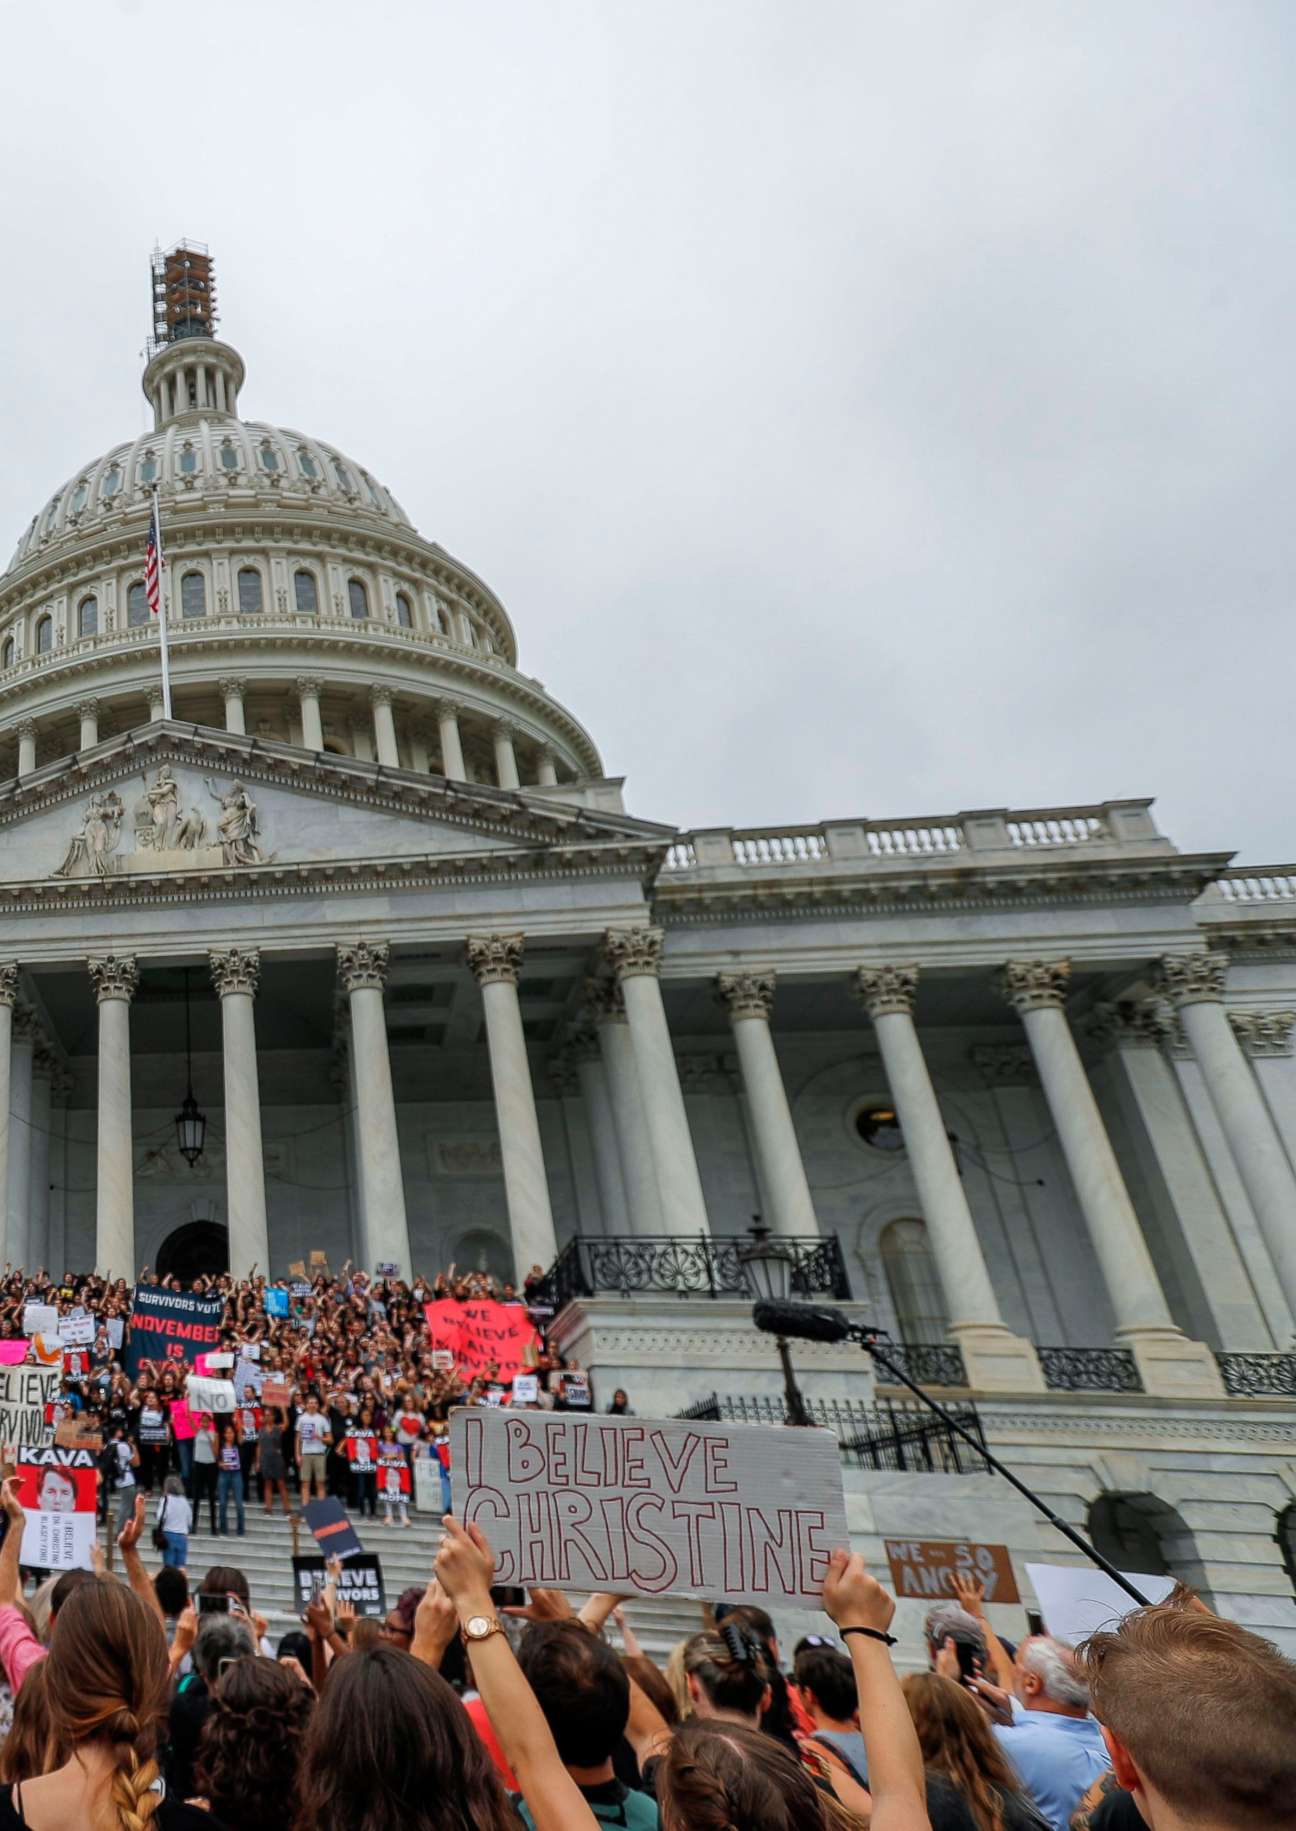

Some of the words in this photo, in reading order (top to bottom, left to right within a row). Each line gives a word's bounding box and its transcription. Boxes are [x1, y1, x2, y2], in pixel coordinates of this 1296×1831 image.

[138, 1292, 195, 1312] SURVIVORS
[166, 1344, 184, 1358] IS
[197, 1393, 228, 1409] NO
[19, 1447, 94, 1466] KAVA
[466, 1418, 483, 1488] I
[504, 1418, 737, 1493] BELIEVE
[464, 1485, 832, 1595] CHRISTINE
[954, 1544, 993, 1573] SO
